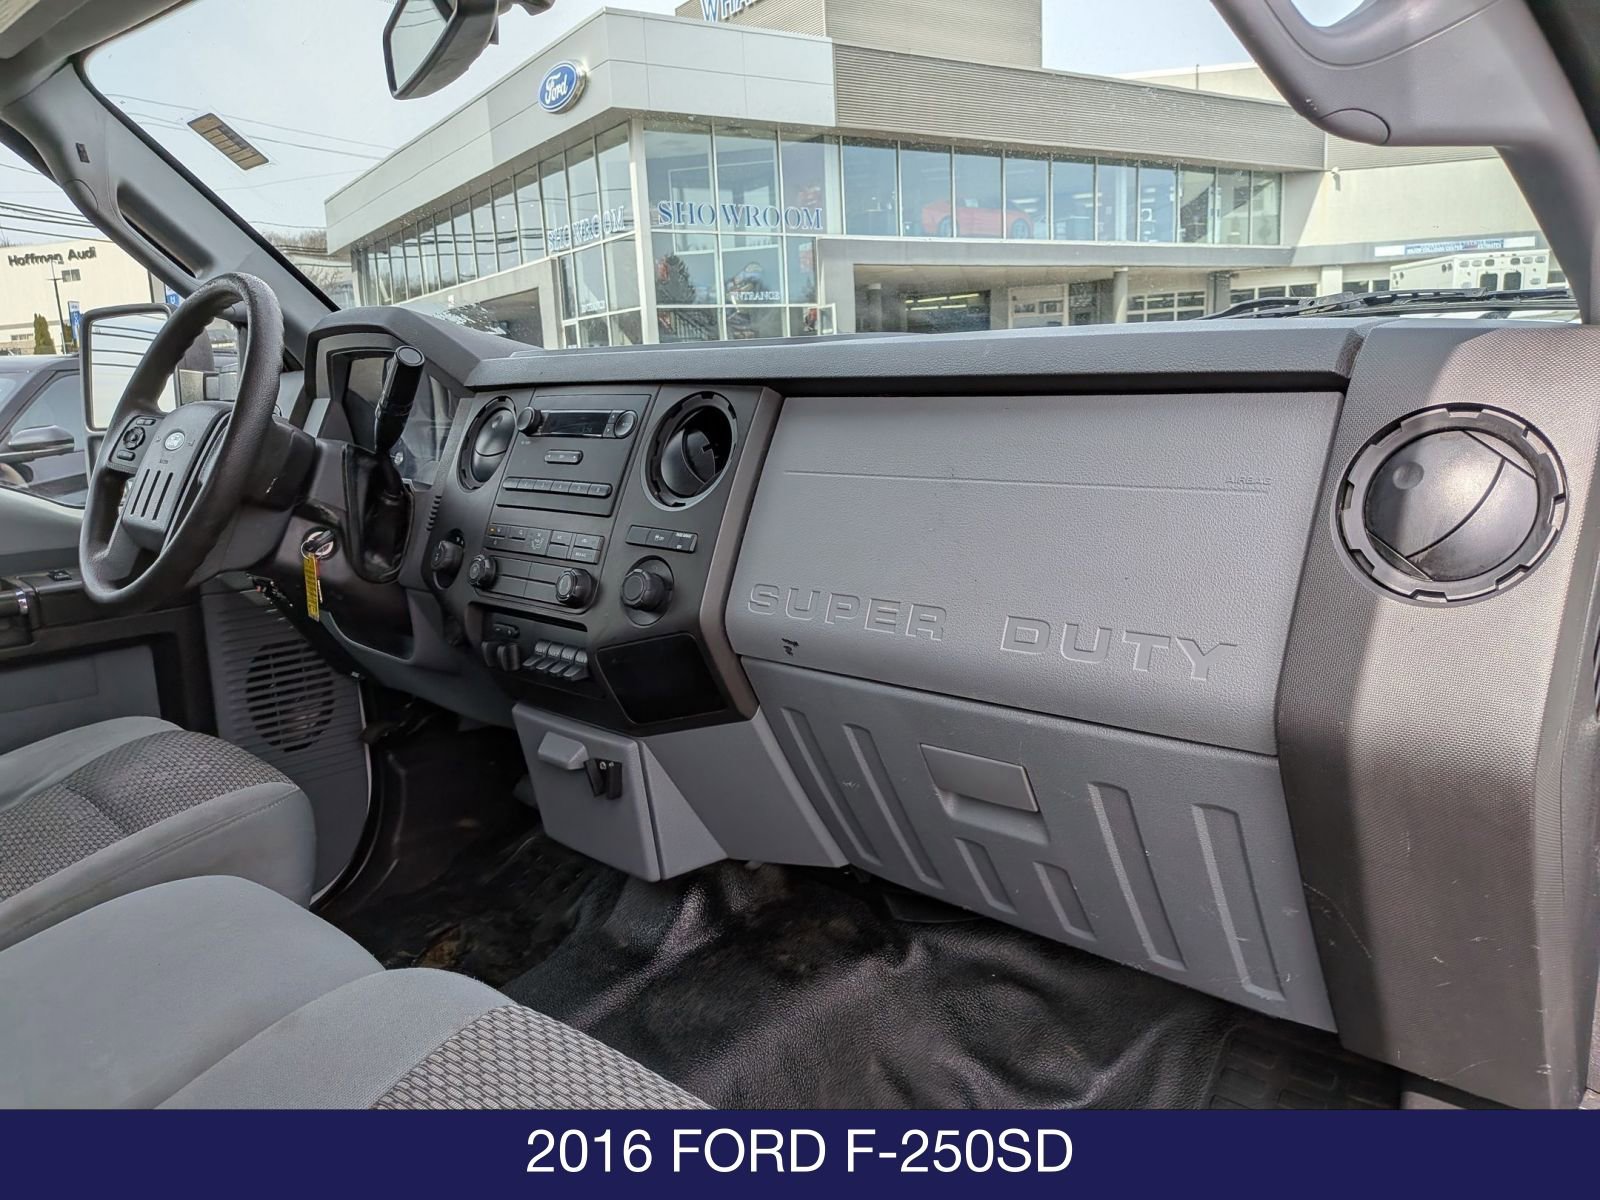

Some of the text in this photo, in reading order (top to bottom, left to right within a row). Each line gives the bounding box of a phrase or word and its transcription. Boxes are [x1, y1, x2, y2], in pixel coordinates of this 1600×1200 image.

[544, 71, 568, 104] Ford
[657, 200, 823, 231] SHOWROOM
[68, 247, 96, 261] Audi
[747, 584, 1237, 682] SUPER DUTY
